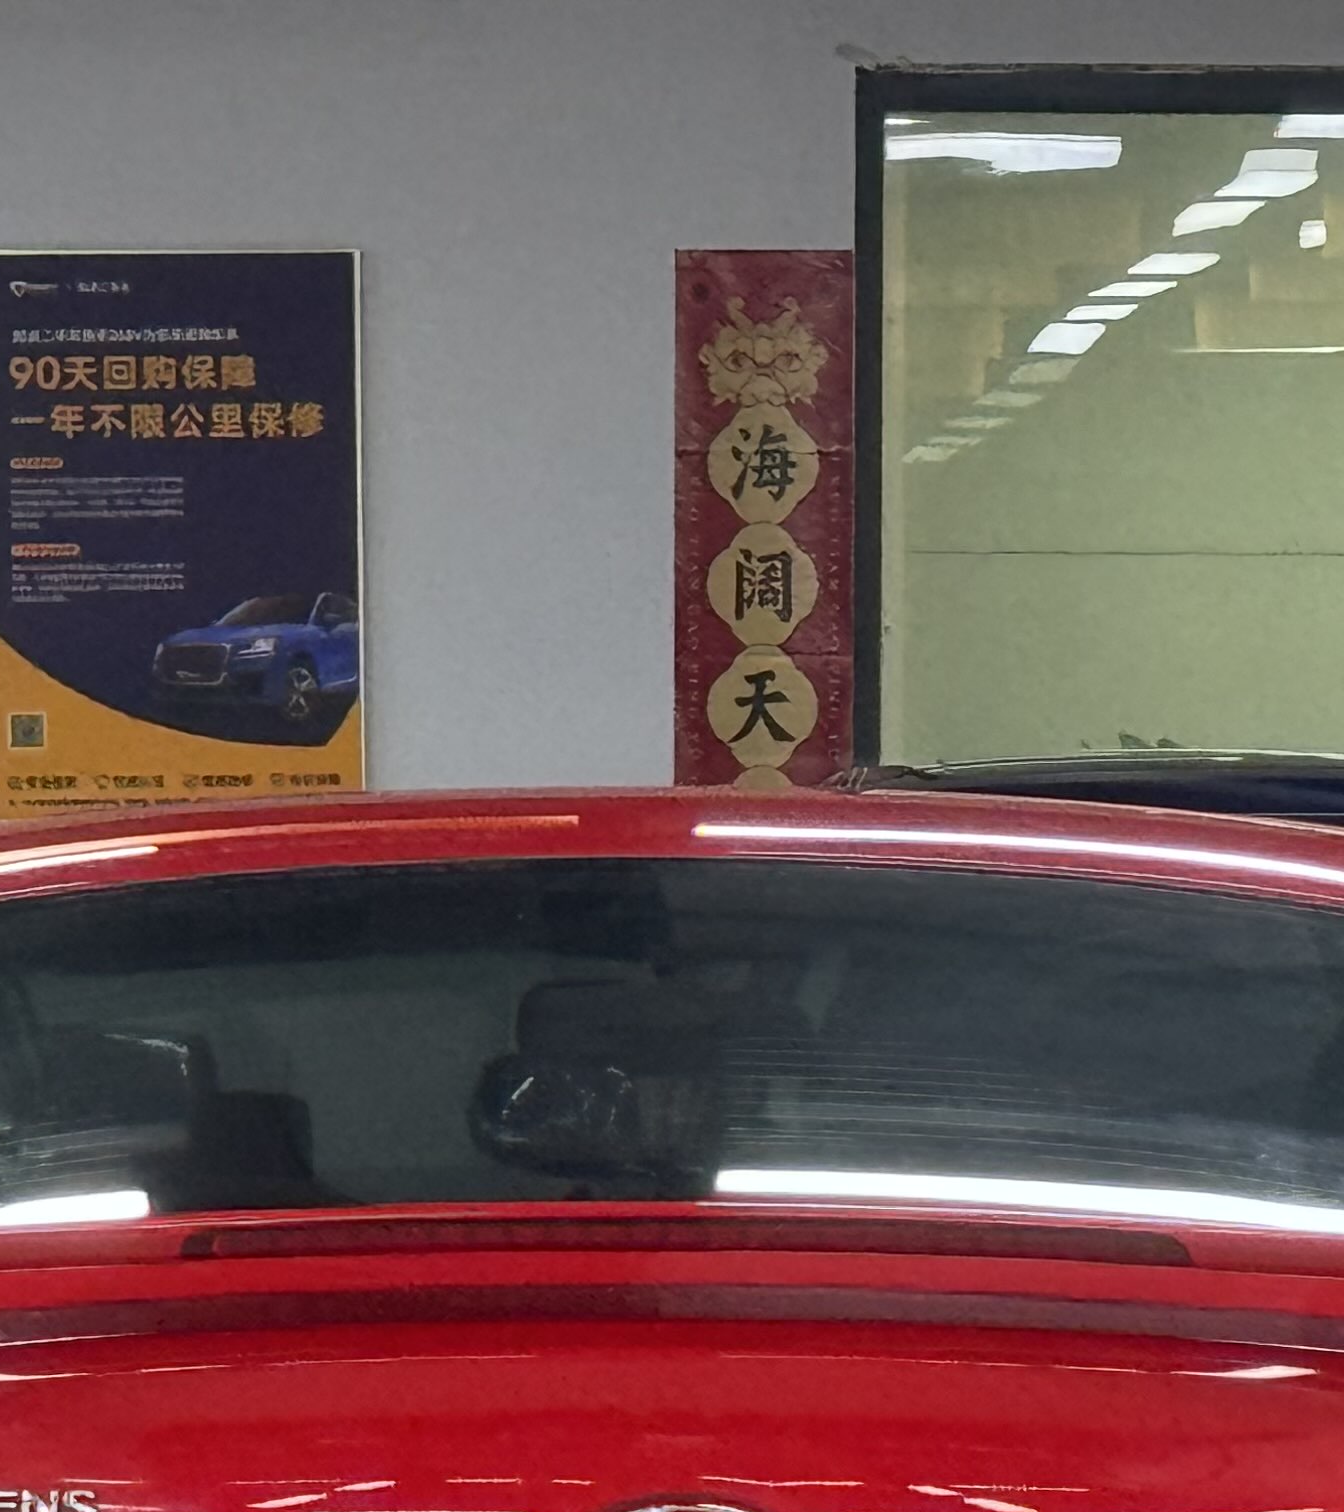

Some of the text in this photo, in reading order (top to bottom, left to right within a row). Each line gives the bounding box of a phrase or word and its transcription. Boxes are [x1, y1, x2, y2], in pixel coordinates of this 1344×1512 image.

[10, 401, 326, 439] 一年不限公里保修
[729, 424, 798, 744] 海阔天
